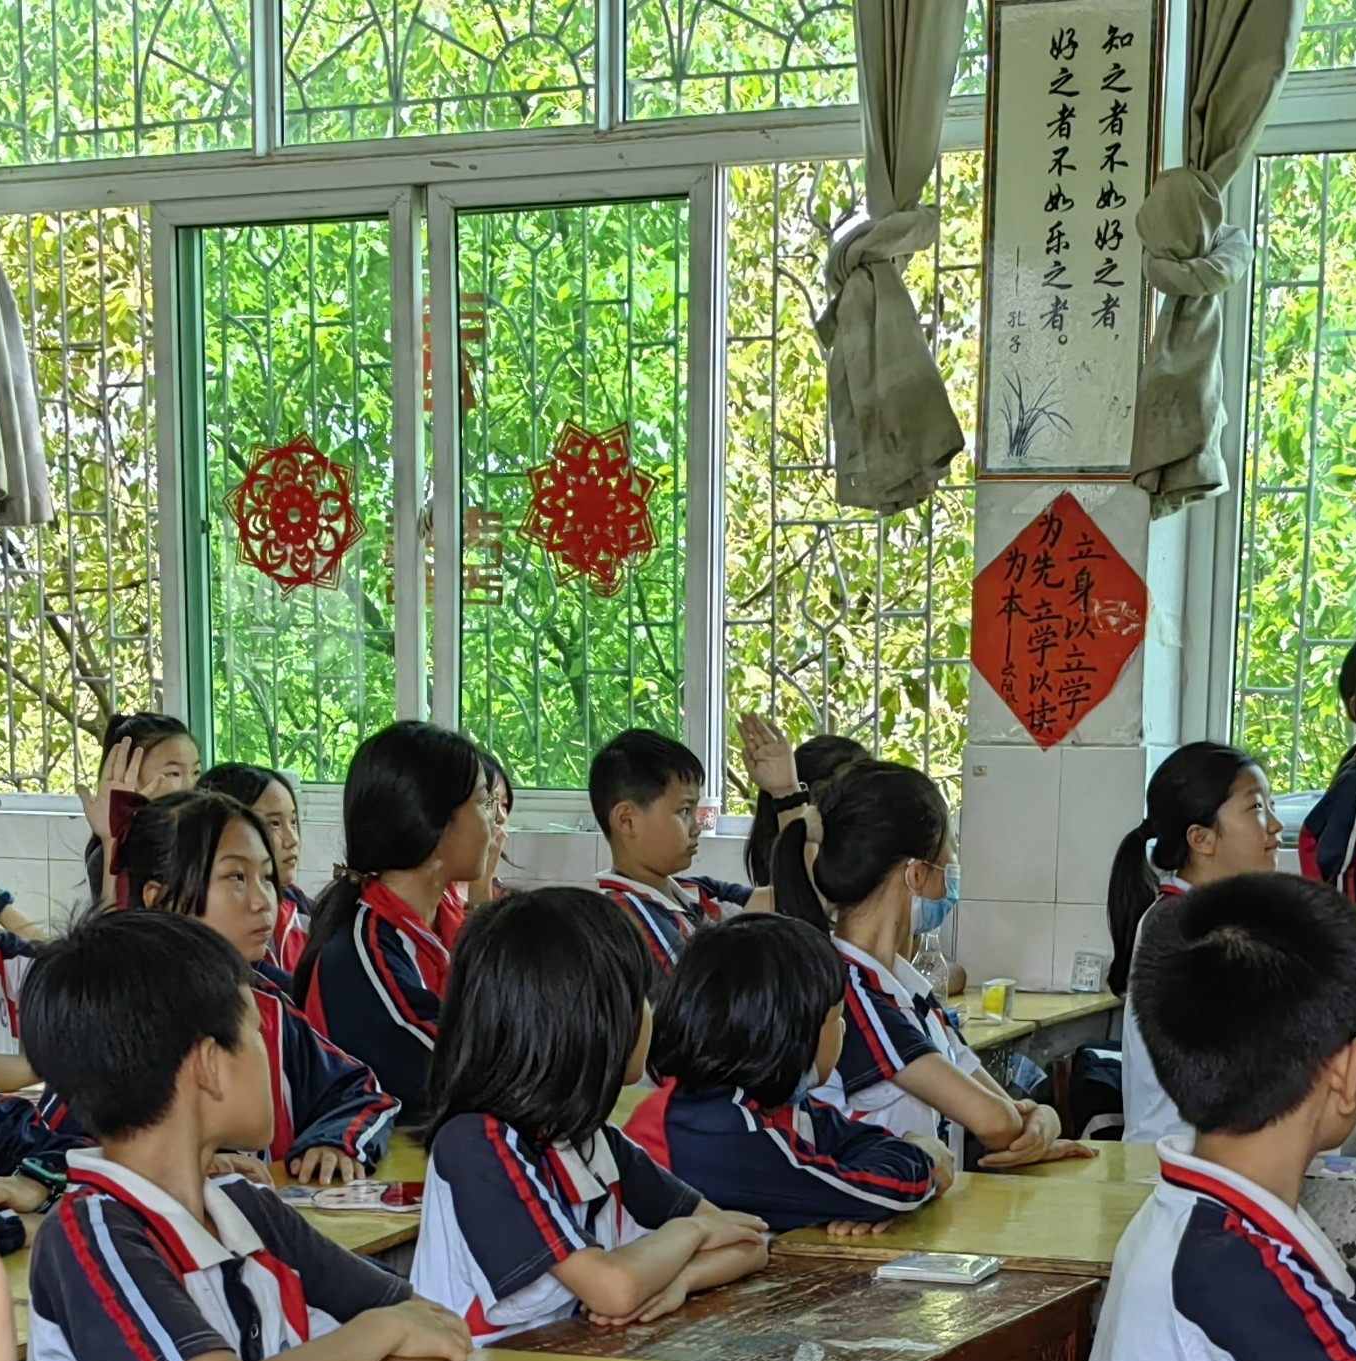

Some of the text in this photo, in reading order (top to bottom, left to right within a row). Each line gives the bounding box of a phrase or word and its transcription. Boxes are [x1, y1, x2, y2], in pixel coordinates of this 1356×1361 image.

[1055, 532, 1107, 721] 立身以立学
